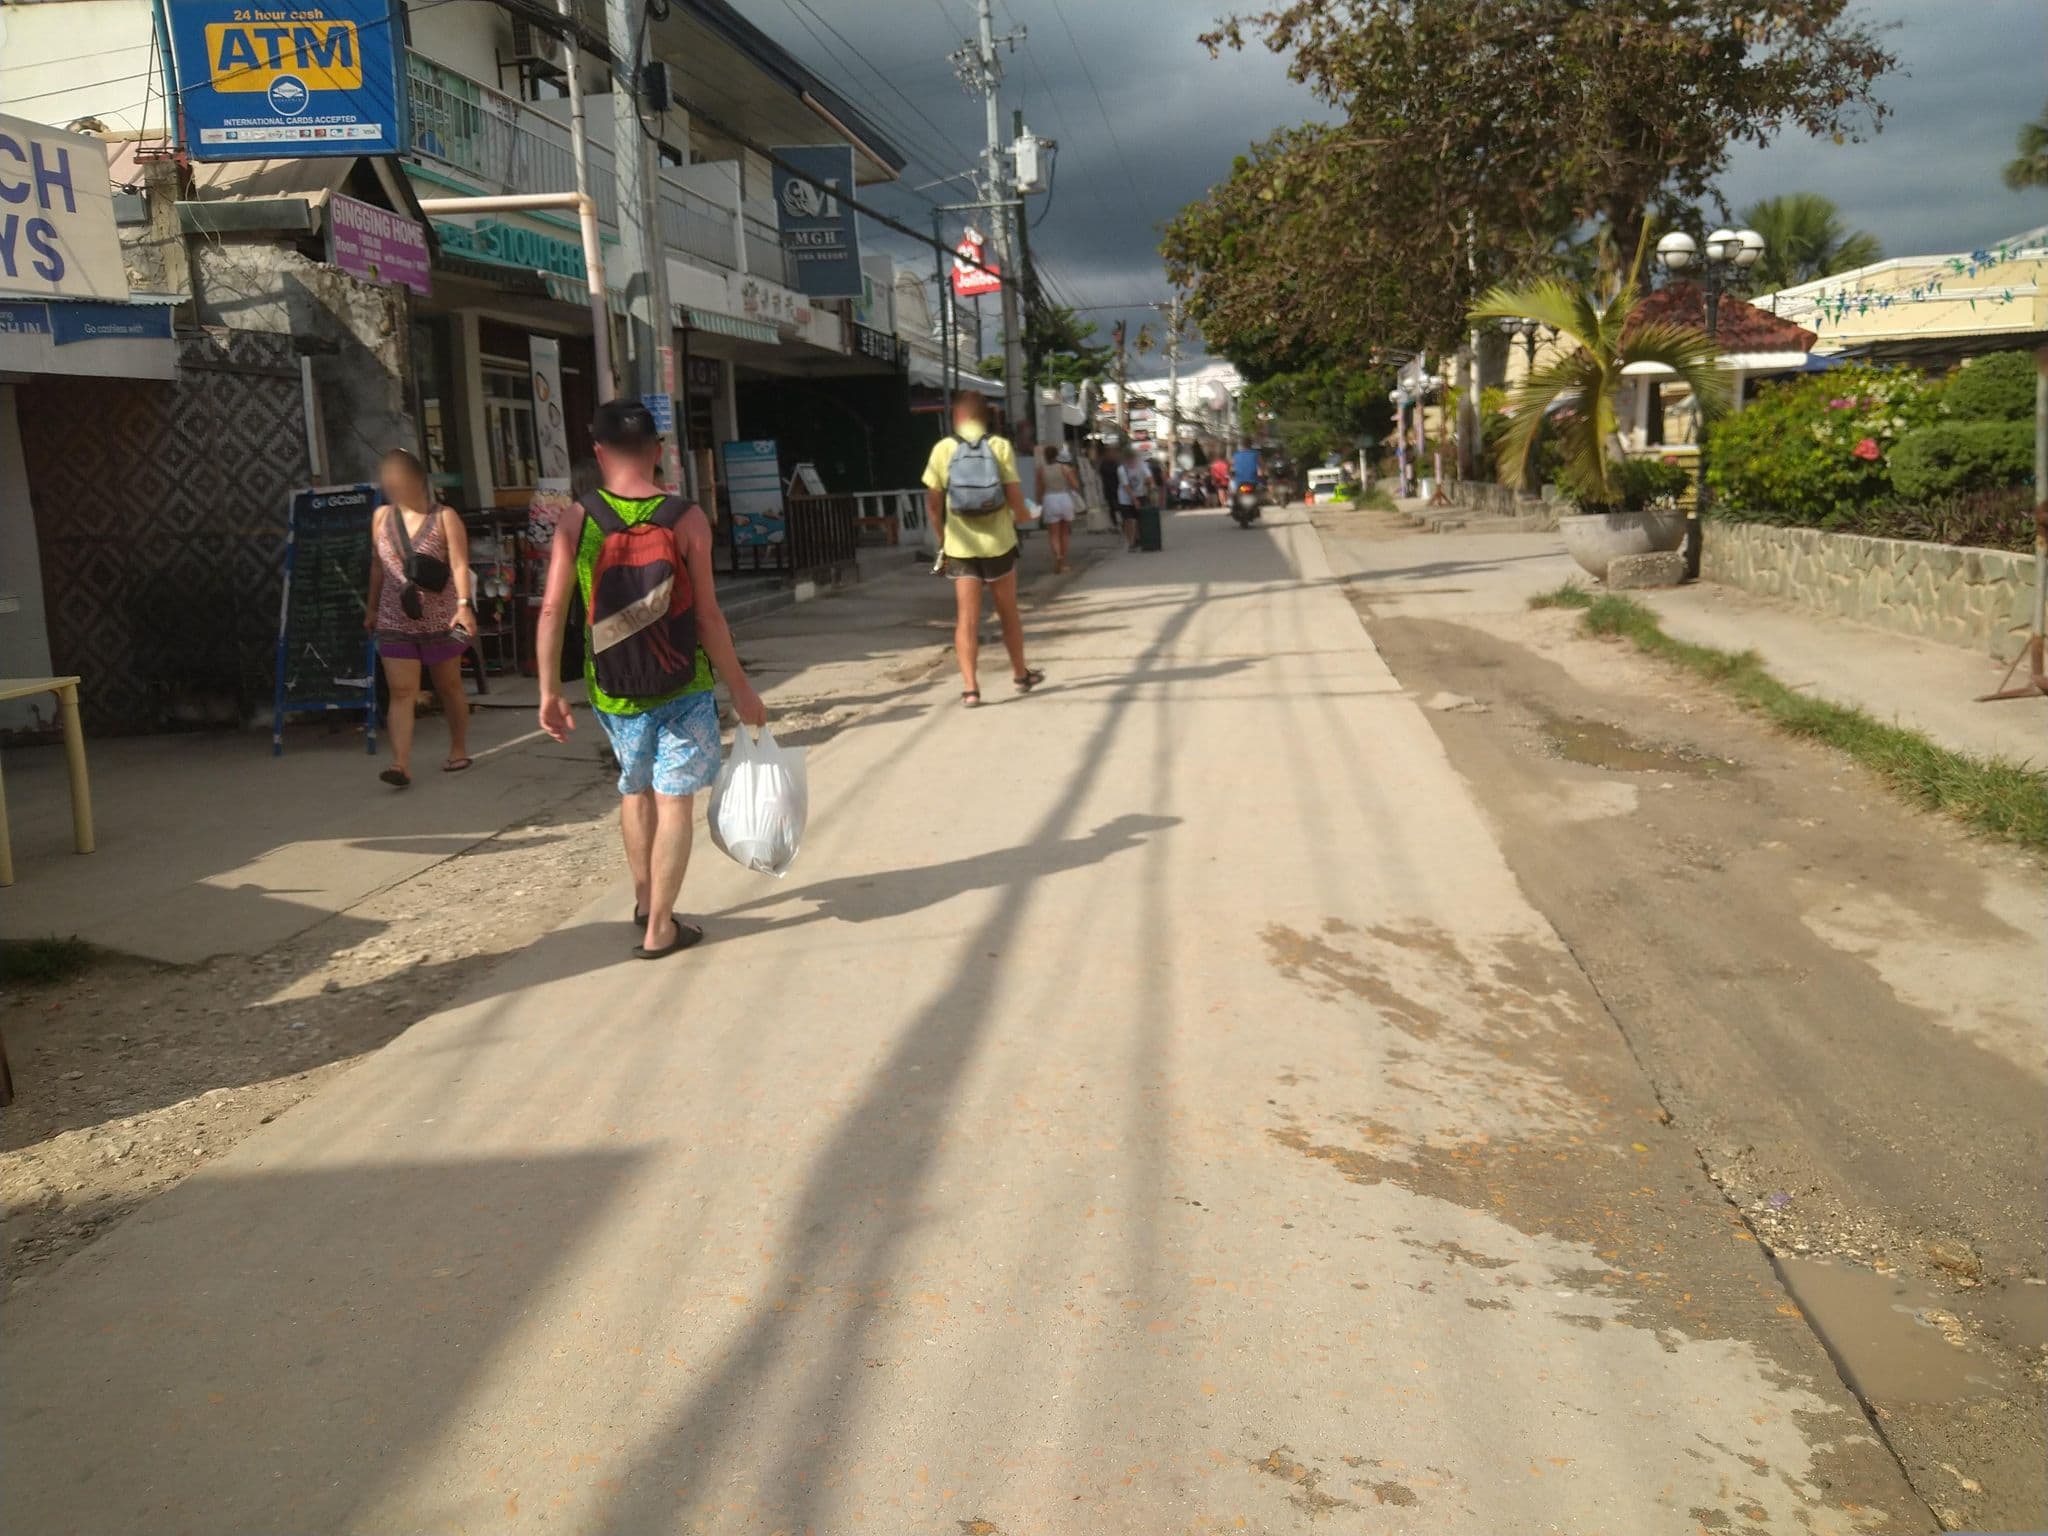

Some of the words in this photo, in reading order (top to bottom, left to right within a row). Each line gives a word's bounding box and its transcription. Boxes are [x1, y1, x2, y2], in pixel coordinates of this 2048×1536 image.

[234, 10, 251, 21] 24
[255, 9, 286, 20] hour
[290, 9, 323, 19] cash
[218, 26, 353, 71] ATM
[224, 117, 284, 127] INTERNATIONAL
[286, 116, 313, 125] CARDS
[315, 115, 357, 124] ACCEPTED
[333, 197, 391, 240] GINGGING
[392, 217, 425, 249] HOME
[795, 231, 836, 245] MGH
[84, 324, 96, 333] Go
[328, 494, 367, 507] GCash
